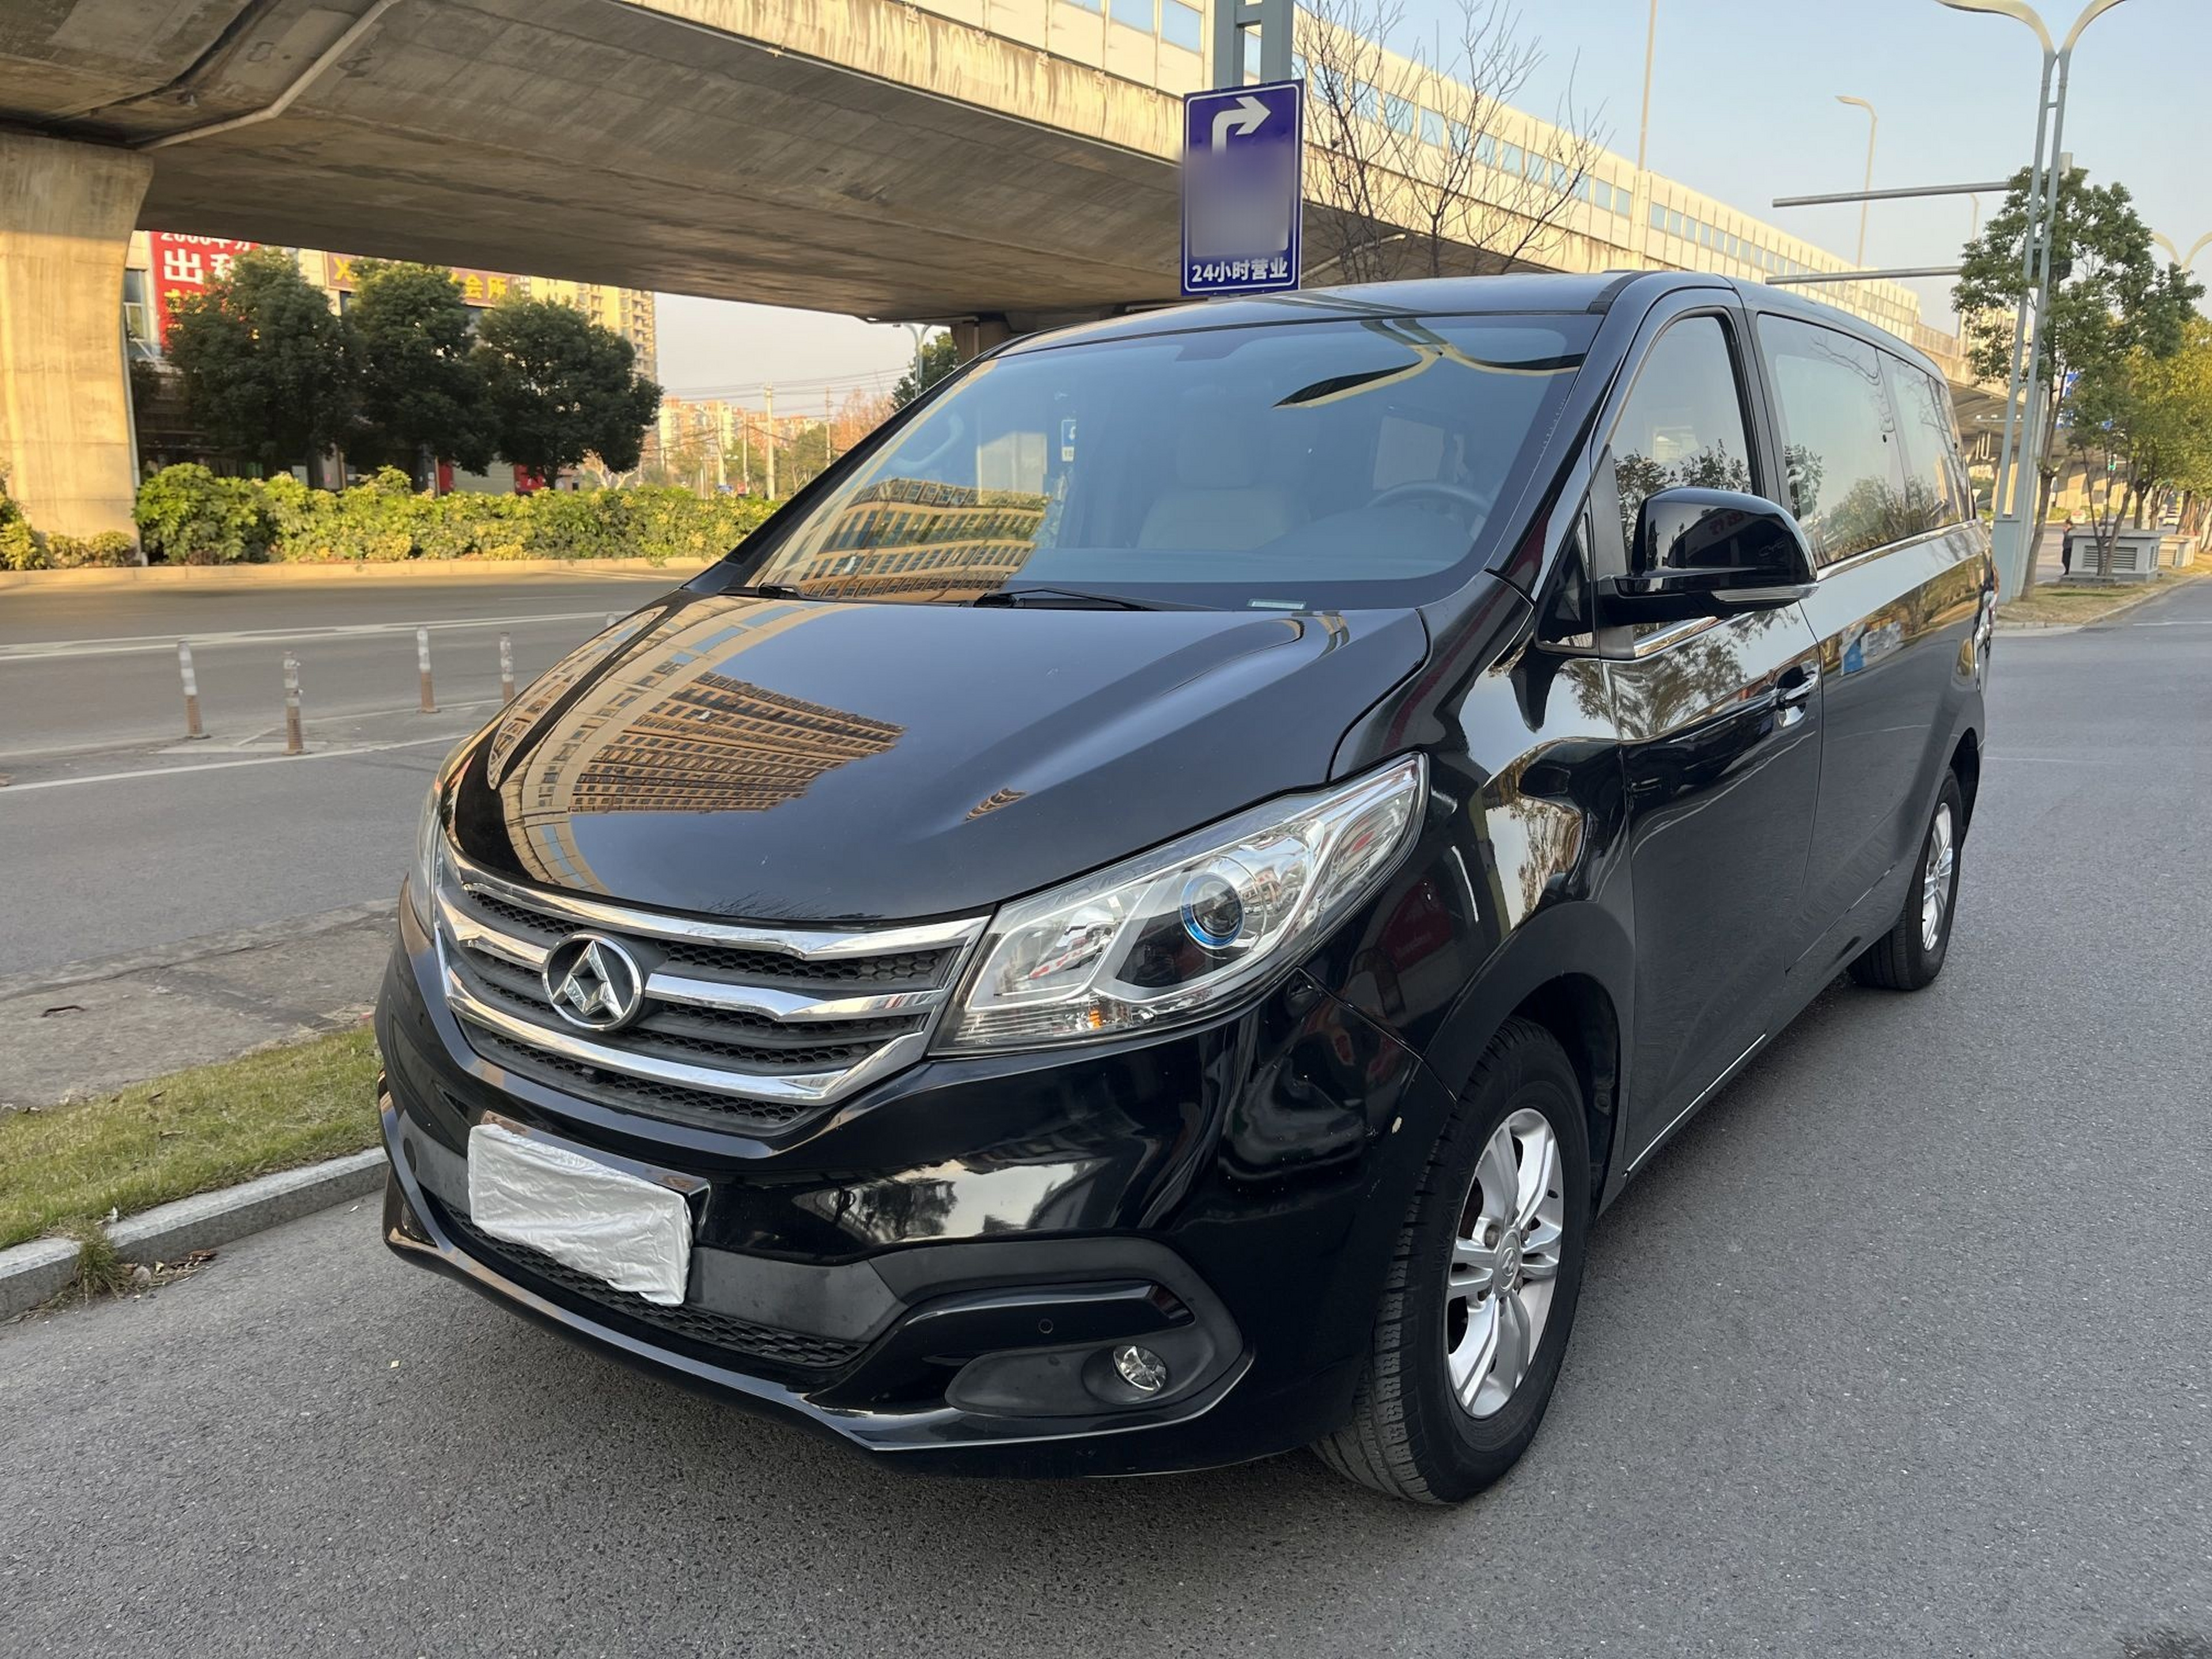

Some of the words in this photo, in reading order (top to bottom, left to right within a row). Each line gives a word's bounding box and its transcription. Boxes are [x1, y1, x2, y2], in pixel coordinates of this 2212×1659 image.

[1192, 257, 1288, 282] 24小时营业
[448, 272, 507, 299] 会所
